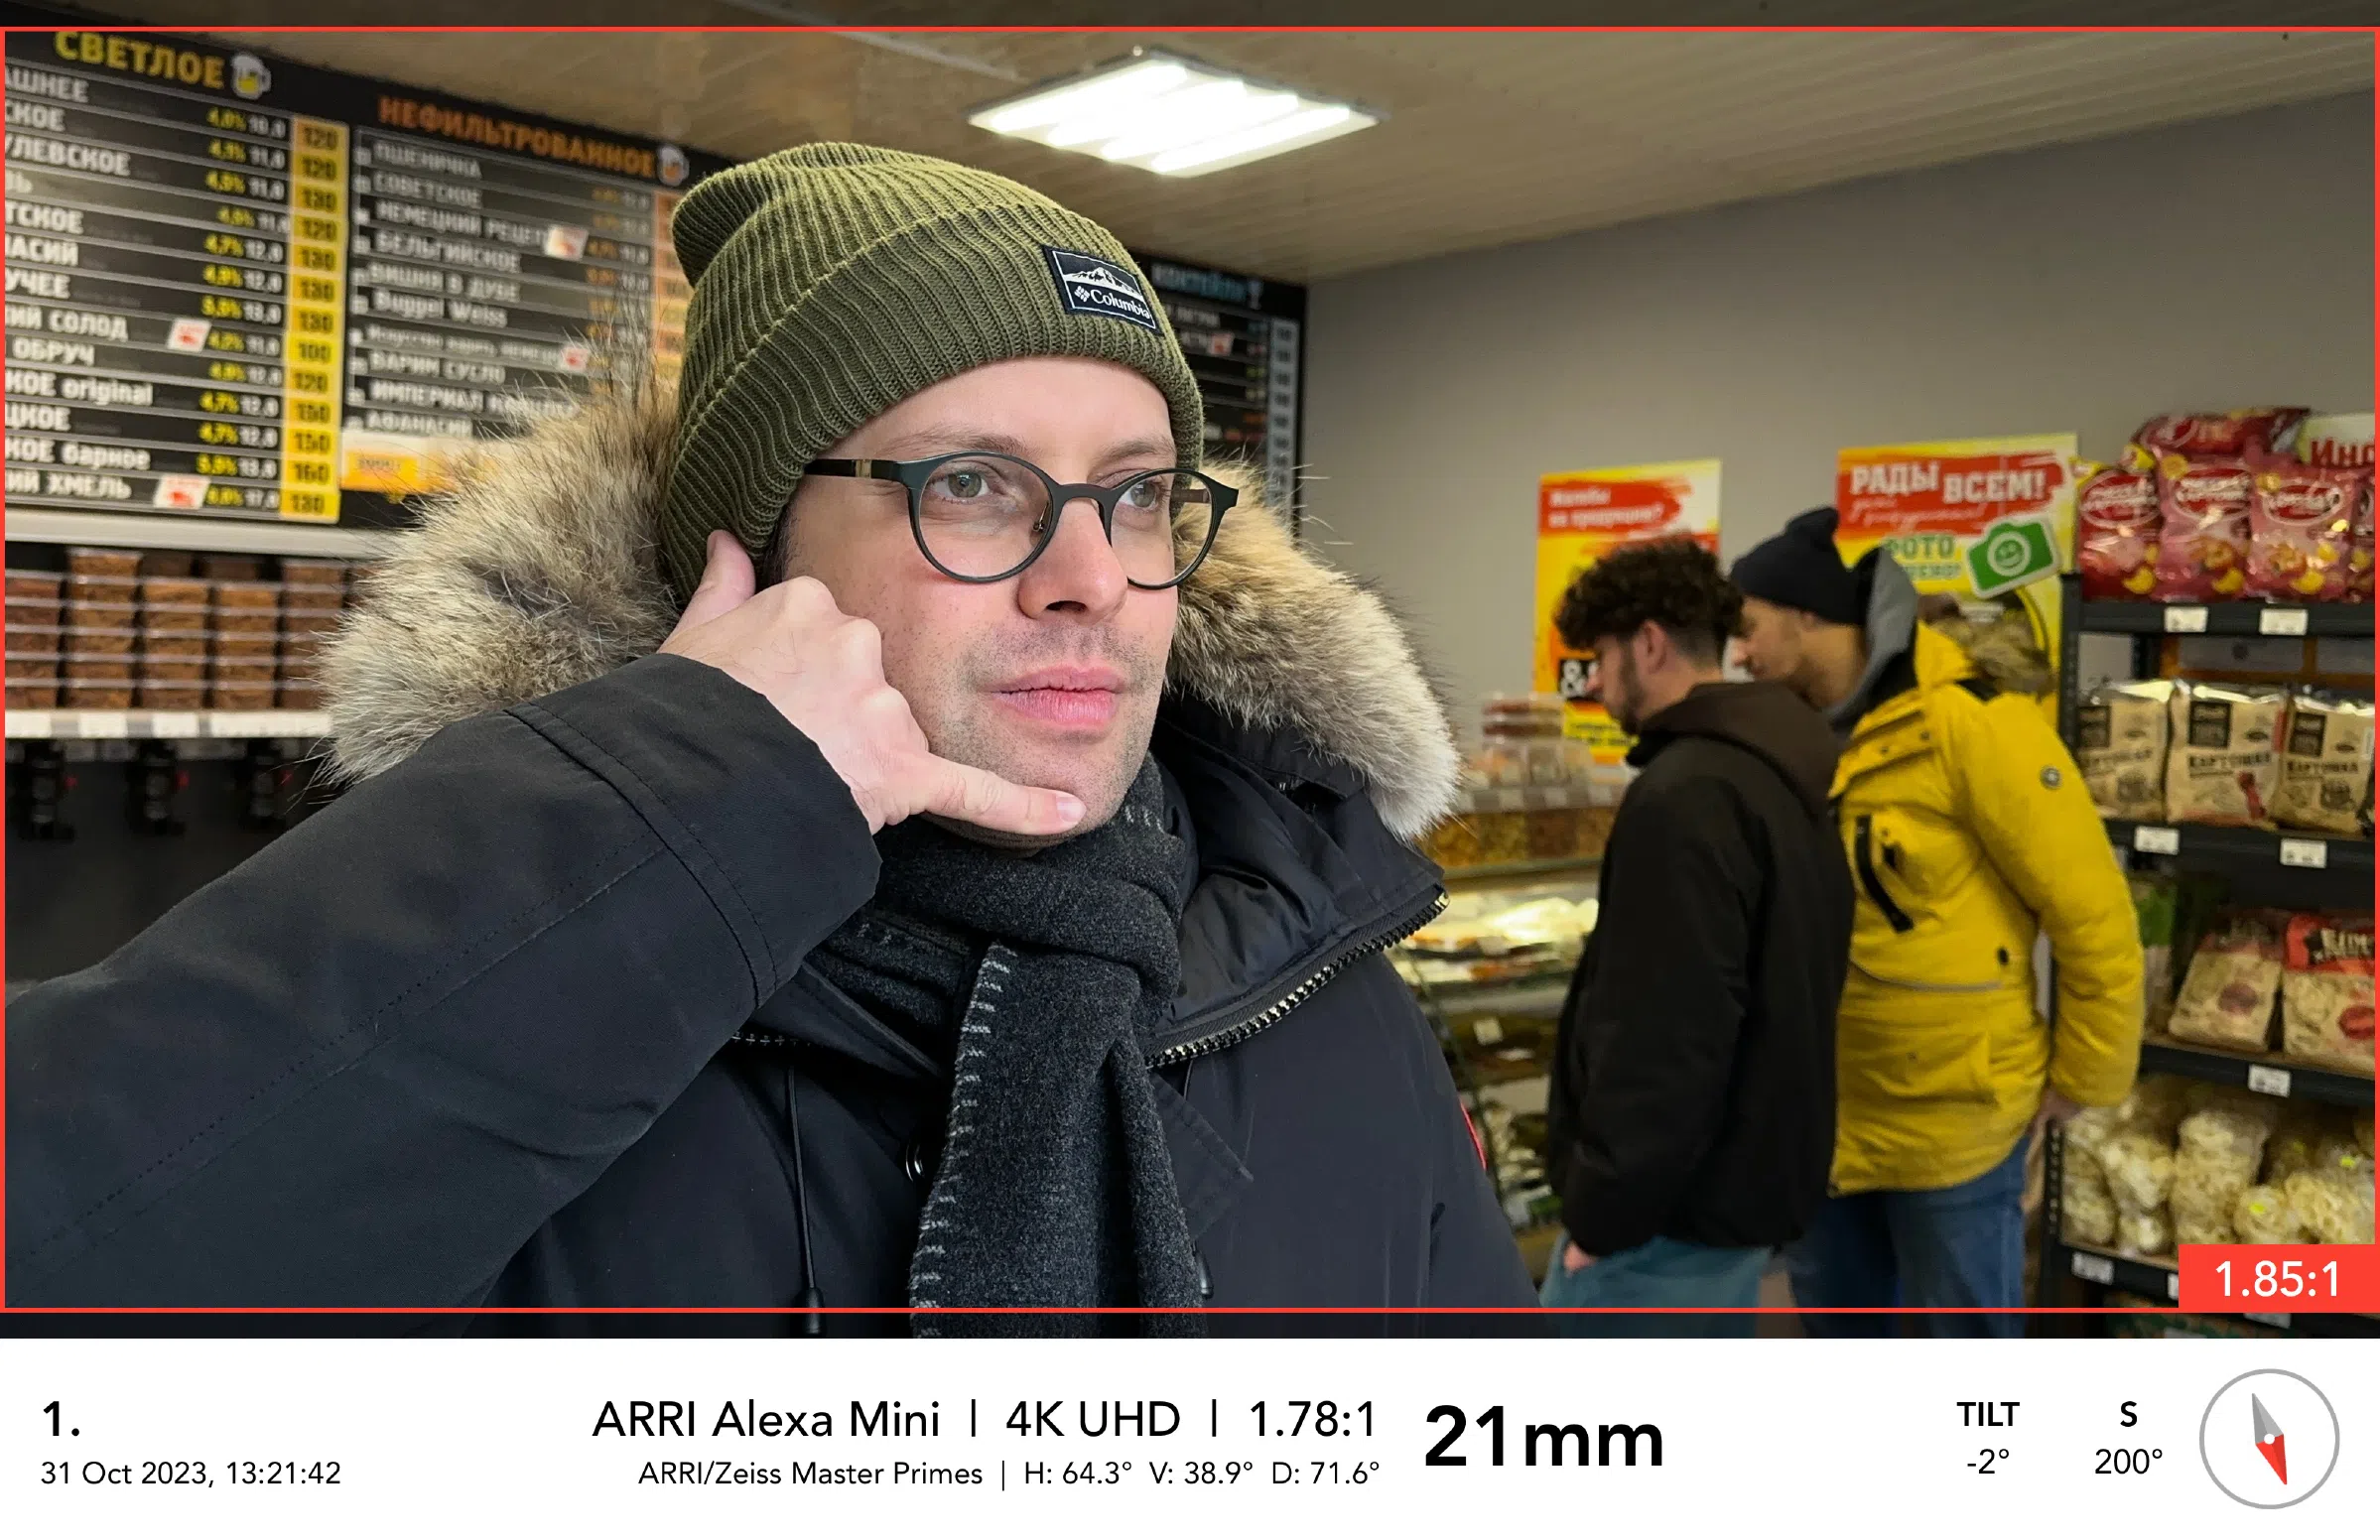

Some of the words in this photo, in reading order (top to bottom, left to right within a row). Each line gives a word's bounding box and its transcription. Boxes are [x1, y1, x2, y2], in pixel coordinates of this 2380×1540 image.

[54, 32, 225, 88] СВЕТЛОЕ
[379, 96, 657, 179] НЕФИЛЬТРОВАННОЕ
[1091, 289, 1151, 320] Columbia
[49, 310, 129, 342] СОЛОД
[13, 336, 95, 366] ОБРУЧ
[62, 378, 153, 406] original
[48, 474, 132, 500] ХМЕЛЬ
[295, 461, 330, 485] 160
[1850, 460, 1941, 496] РАДЫ
[1943, 470, 2046, 504] ВСЕМ!
